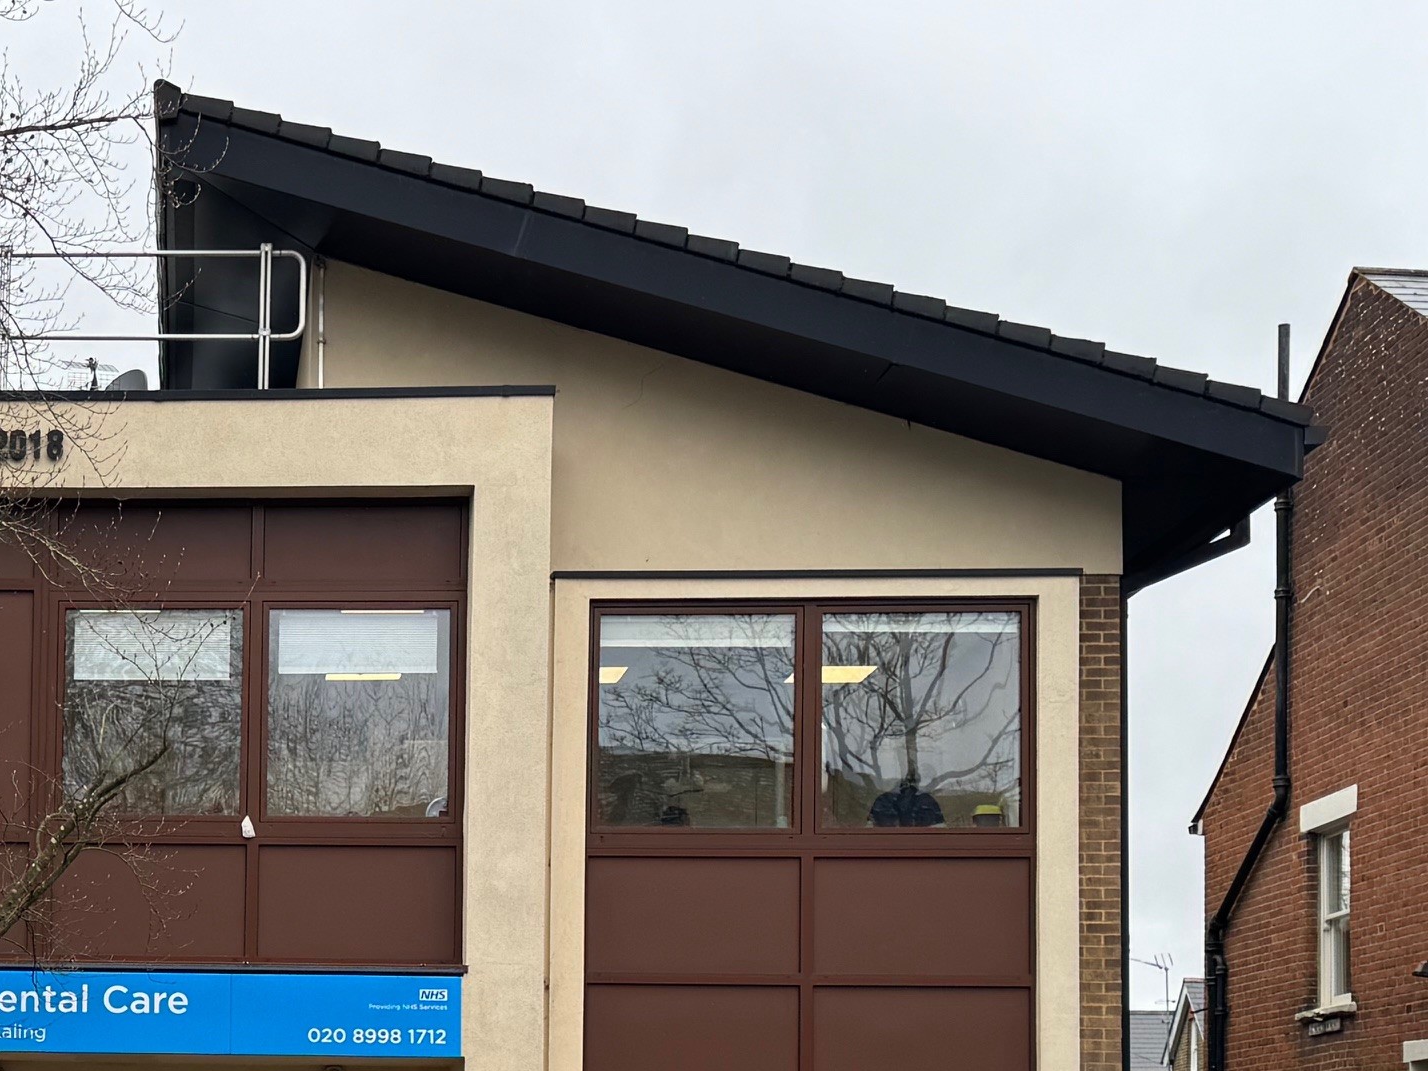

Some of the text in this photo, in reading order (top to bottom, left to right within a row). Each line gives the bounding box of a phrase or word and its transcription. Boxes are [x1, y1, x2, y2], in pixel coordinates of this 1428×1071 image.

[103, 985, 188, 1014] Care
[420, 990, 446, 1000] NHS
[307, 1028, 446, 1044] 020 8998 1712
